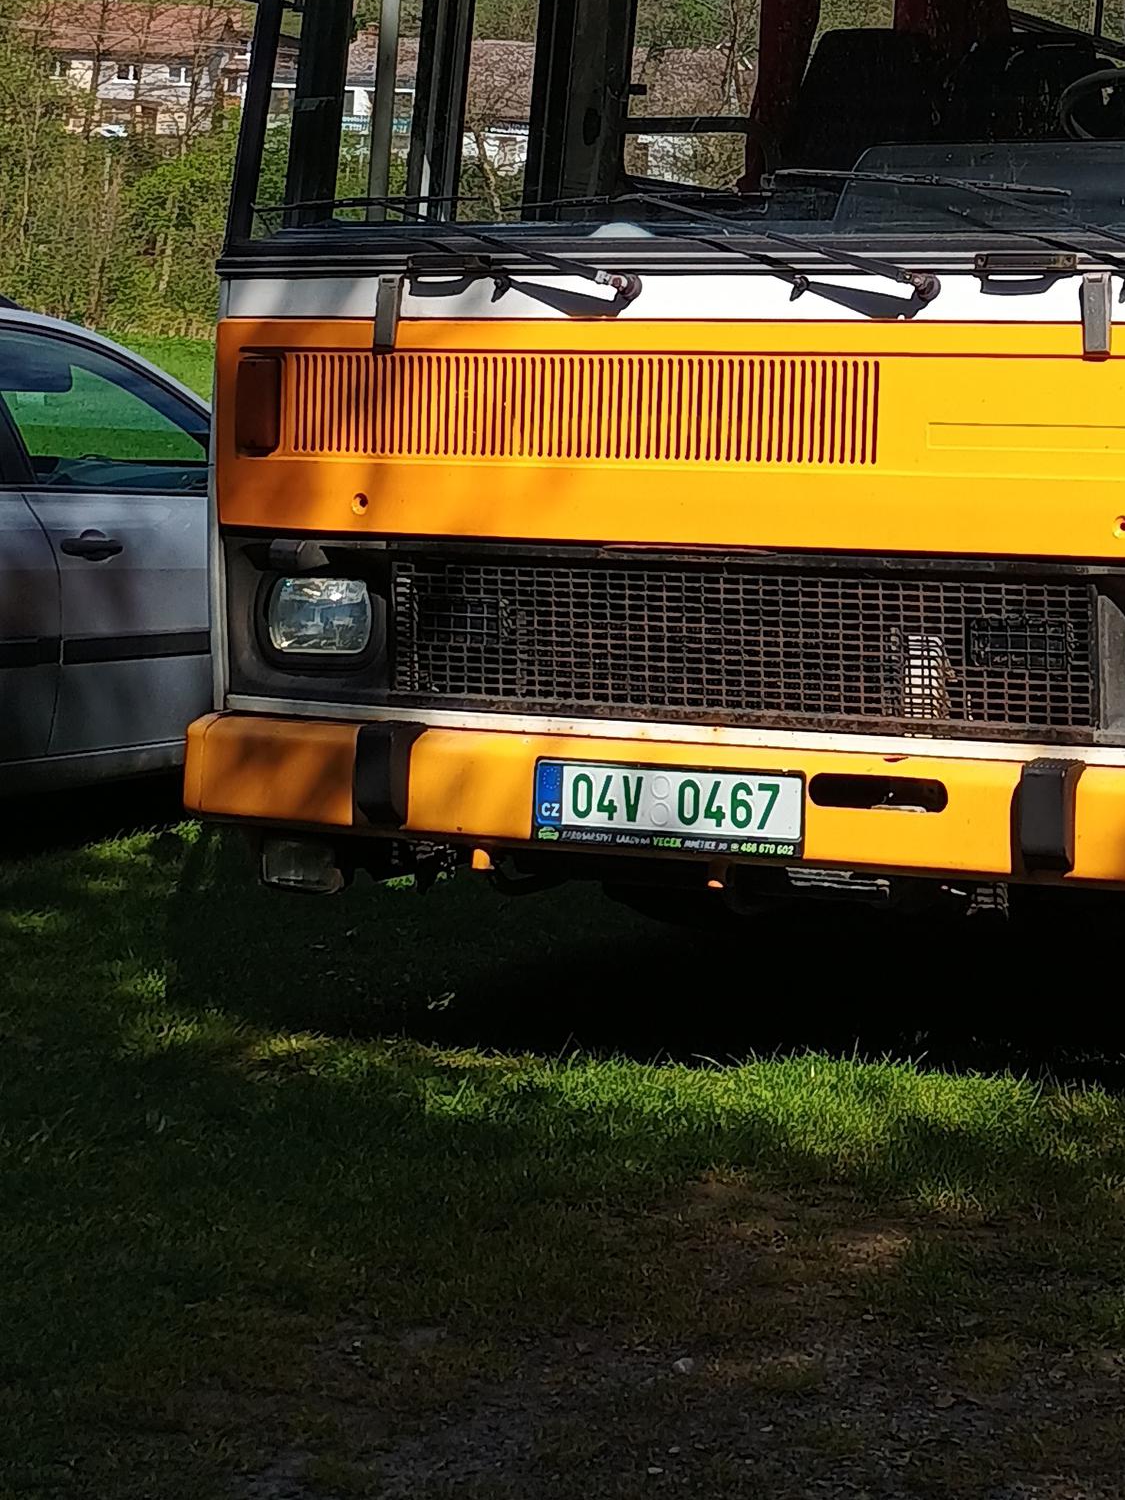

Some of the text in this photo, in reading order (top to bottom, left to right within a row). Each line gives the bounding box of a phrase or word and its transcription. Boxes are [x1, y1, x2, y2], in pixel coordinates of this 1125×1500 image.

[541, 802, 560, 817] CZ
[571, 773, 781, 831] 04V 0467
